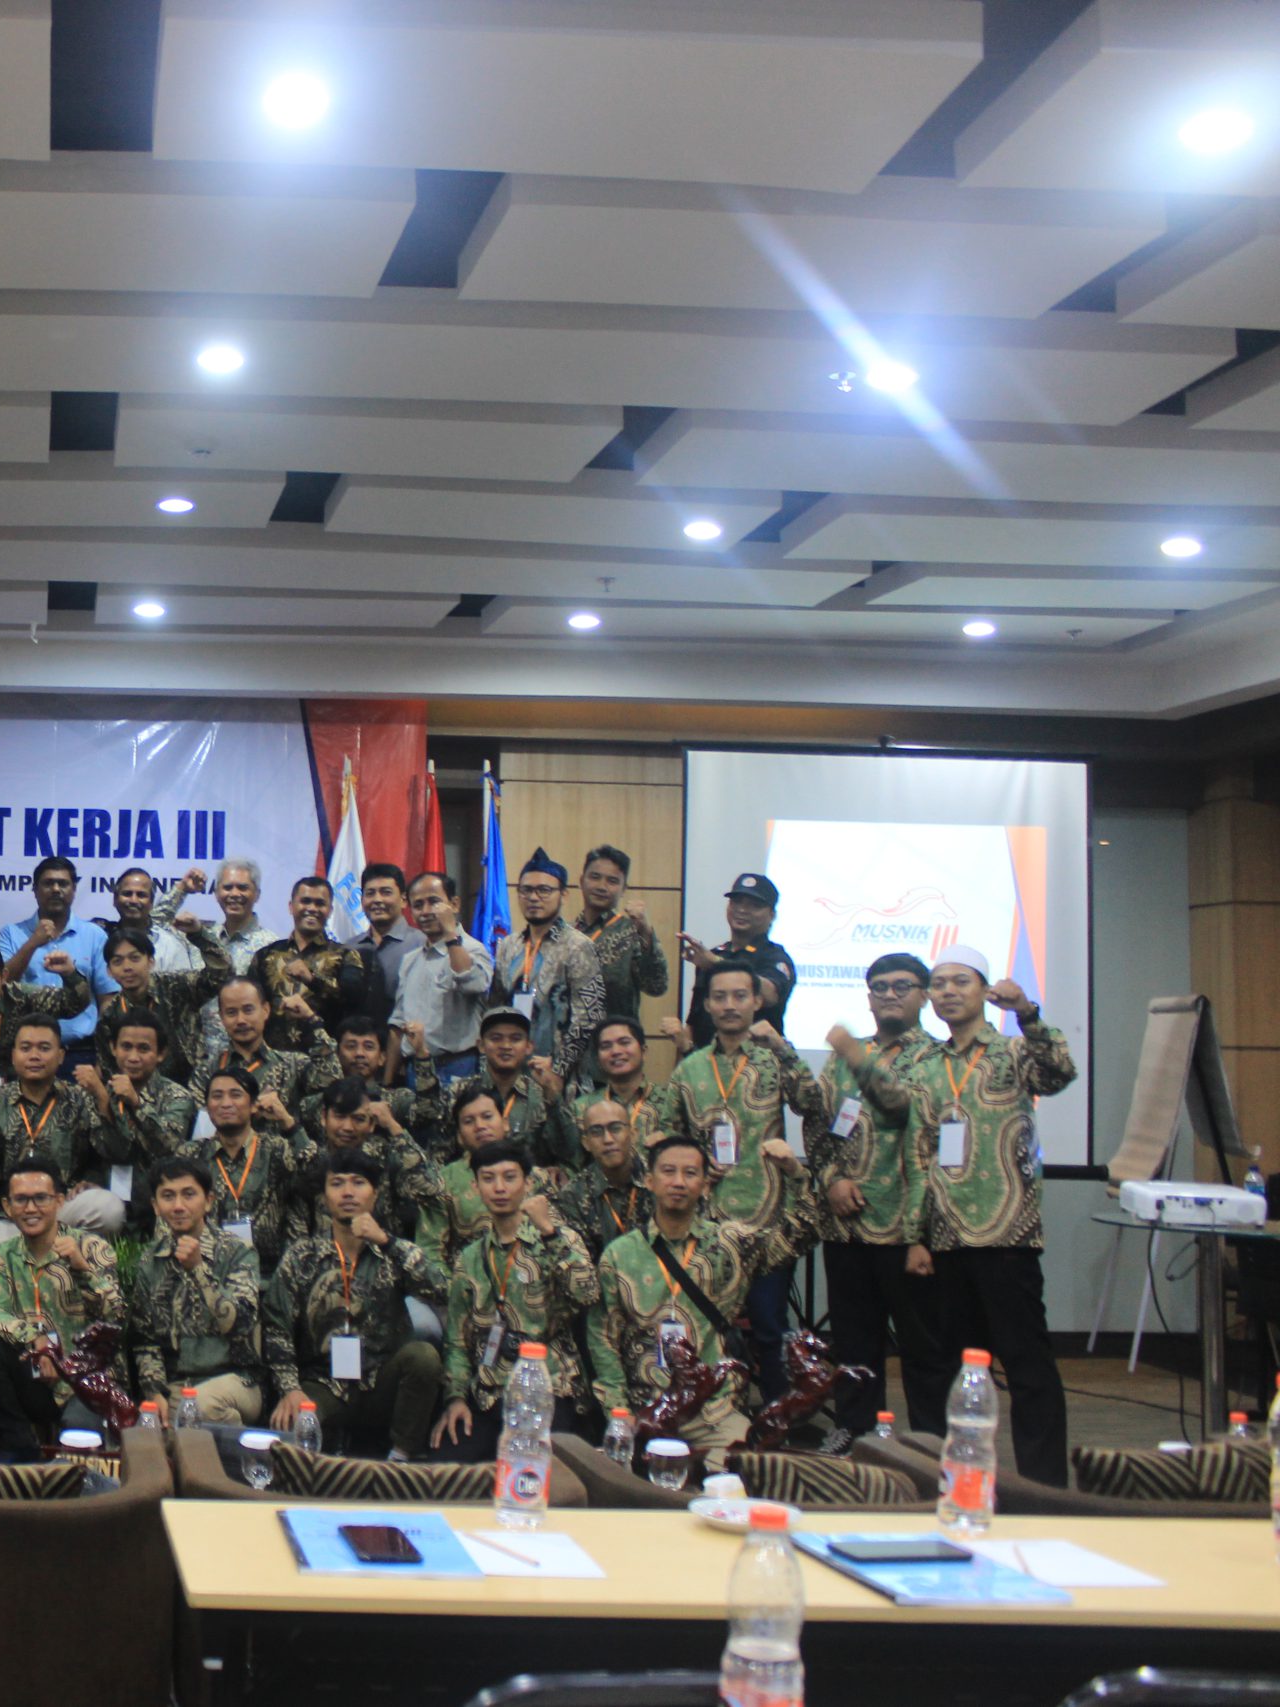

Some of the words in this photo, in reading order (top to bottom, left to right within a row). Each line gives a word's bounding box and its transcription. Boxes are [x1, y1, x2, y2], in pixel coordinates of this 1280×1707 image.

[23, 807, 164, 860] KERJA
[176, 809, 227, 861] III
[851, 923, 933, 940] MUSNIK
